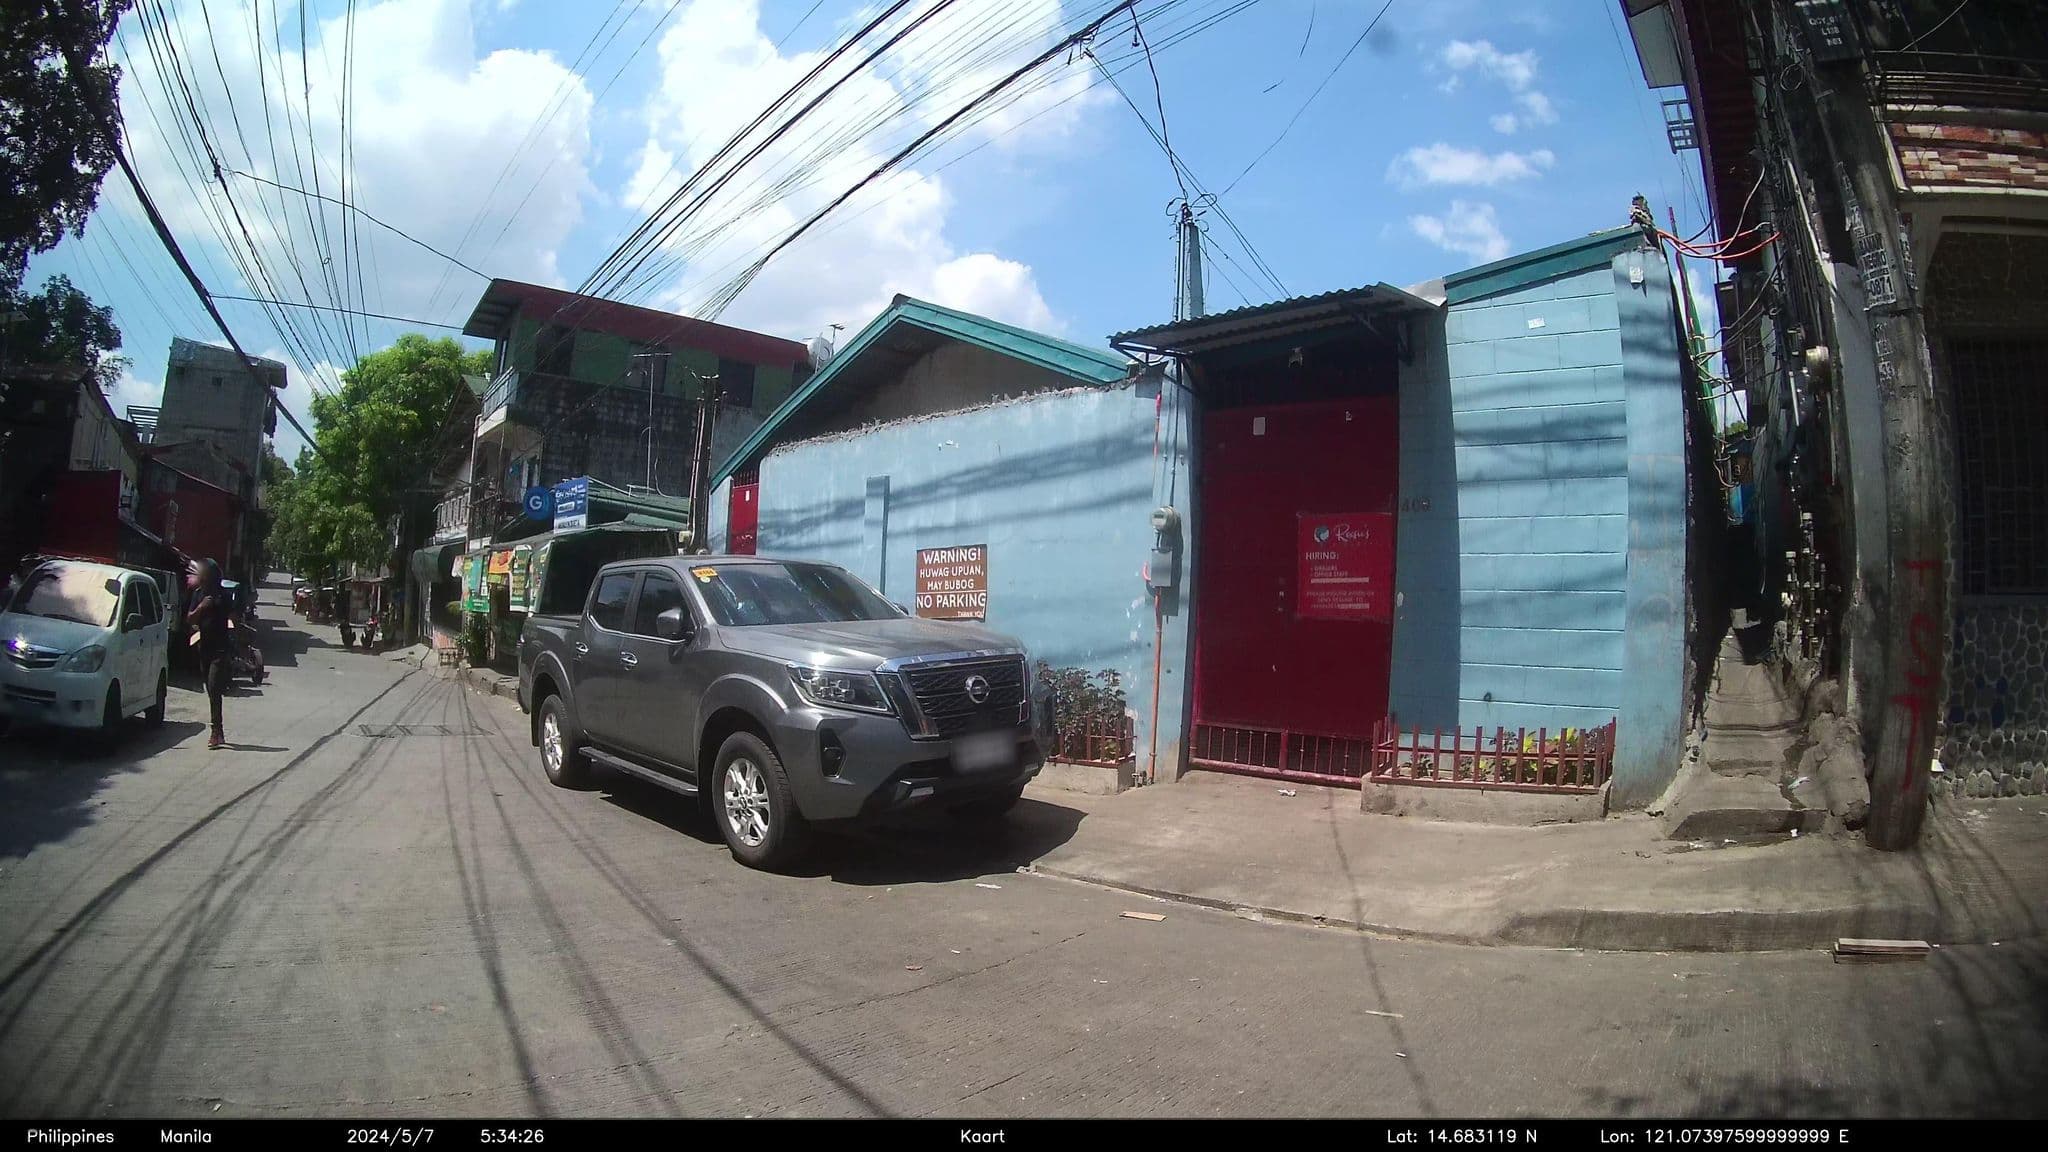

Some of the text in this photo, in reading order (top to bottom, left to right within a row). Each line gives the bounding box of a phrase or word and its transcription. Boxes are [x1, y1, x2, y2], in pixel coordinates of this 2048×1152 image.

[922, 547, 981, 565] WARNING!
[920, 565, 984, 578] HUWAG UPUAN,
[927, 579, 974, 591] MAY BUBOG
[916, 593, 986, 609] NO PARKING
